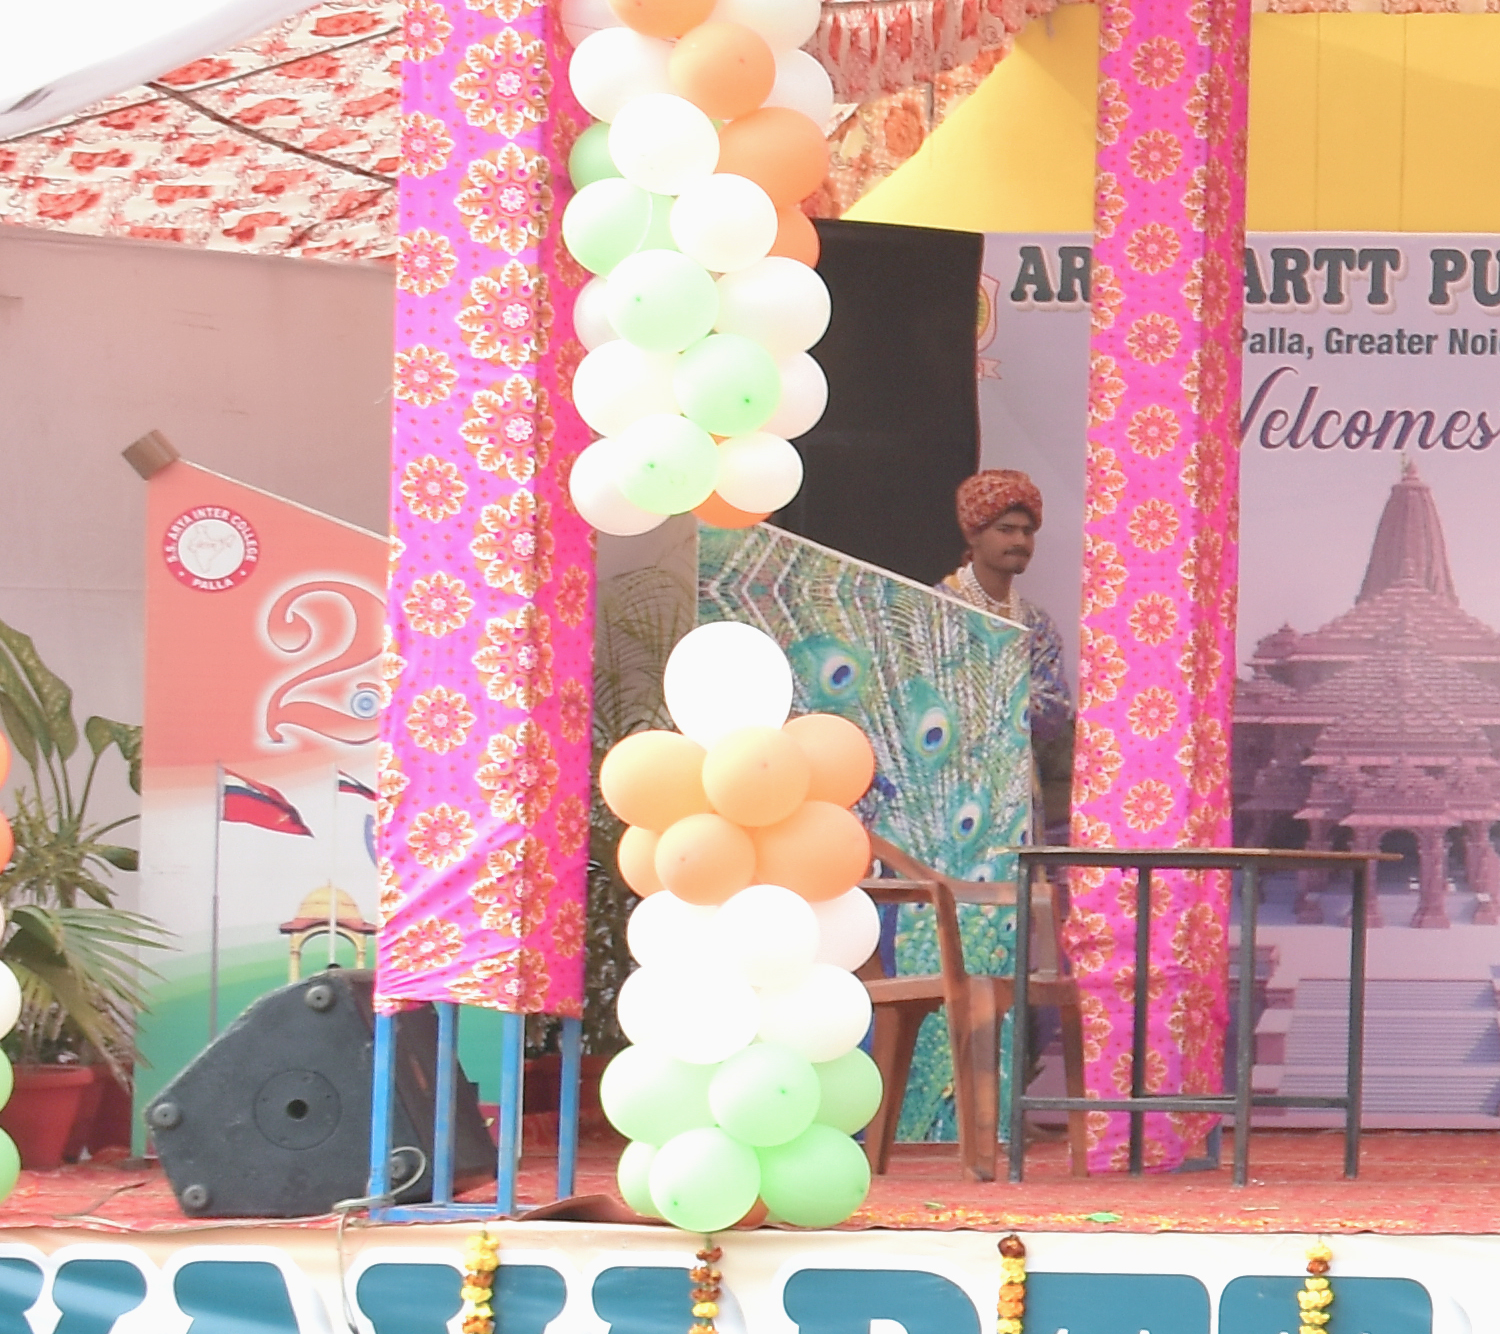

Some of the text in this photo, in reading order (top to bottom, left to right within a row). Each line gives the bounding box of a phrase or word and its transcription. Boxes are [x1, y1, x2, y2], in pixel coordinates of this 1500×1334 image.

[1010, 245, 1400, 305] ARARTT
[1238, 327, 1314, 359] alla,
[1324, 327, 1438, 355] Greater
